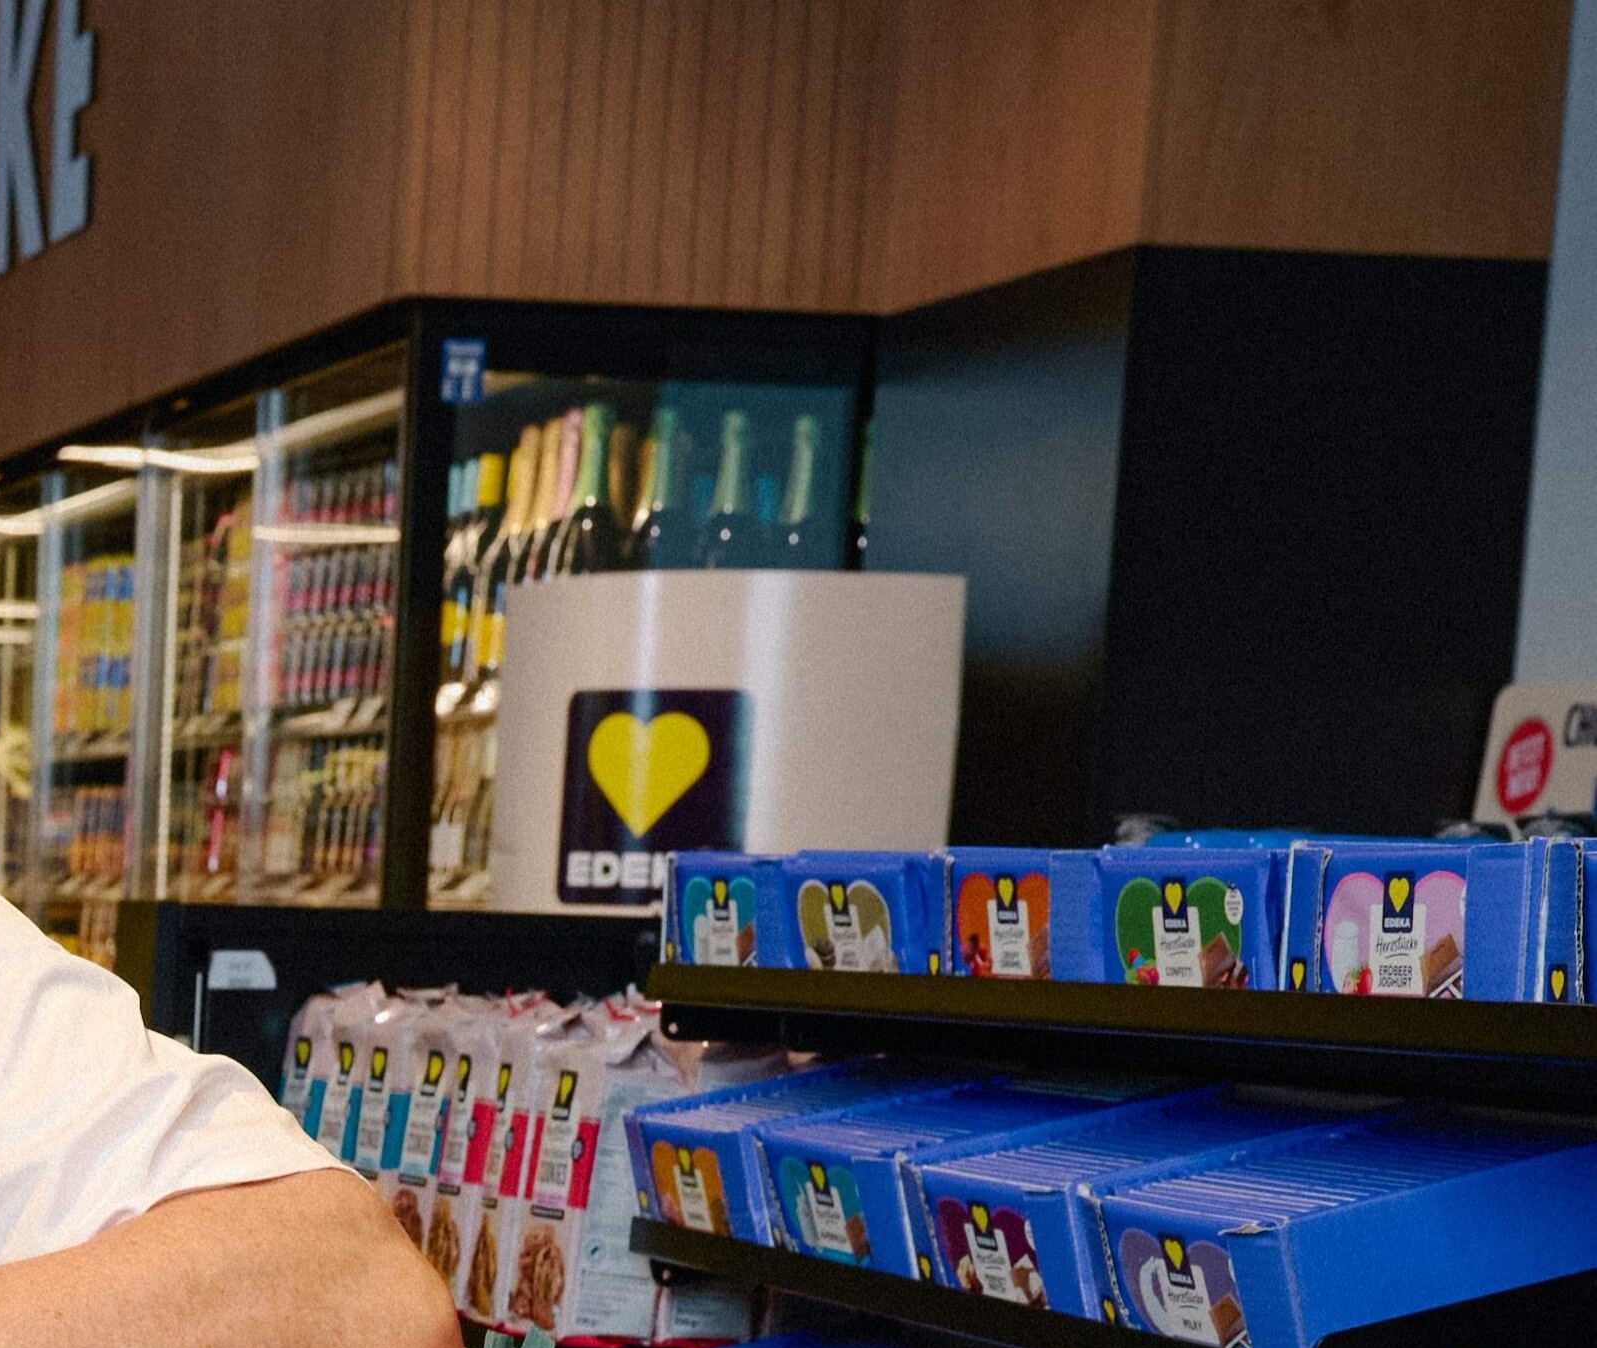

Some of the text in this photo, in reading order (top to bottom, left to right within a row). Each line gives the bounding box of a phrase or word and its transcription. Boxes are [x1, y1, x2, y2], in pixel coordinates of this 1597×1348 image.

[1384, 917, 1410, 929] EDEKA
[1378, 965, 1413, 977] ERDBEER
[1378, 976, 1413, 989] JOGHURT
